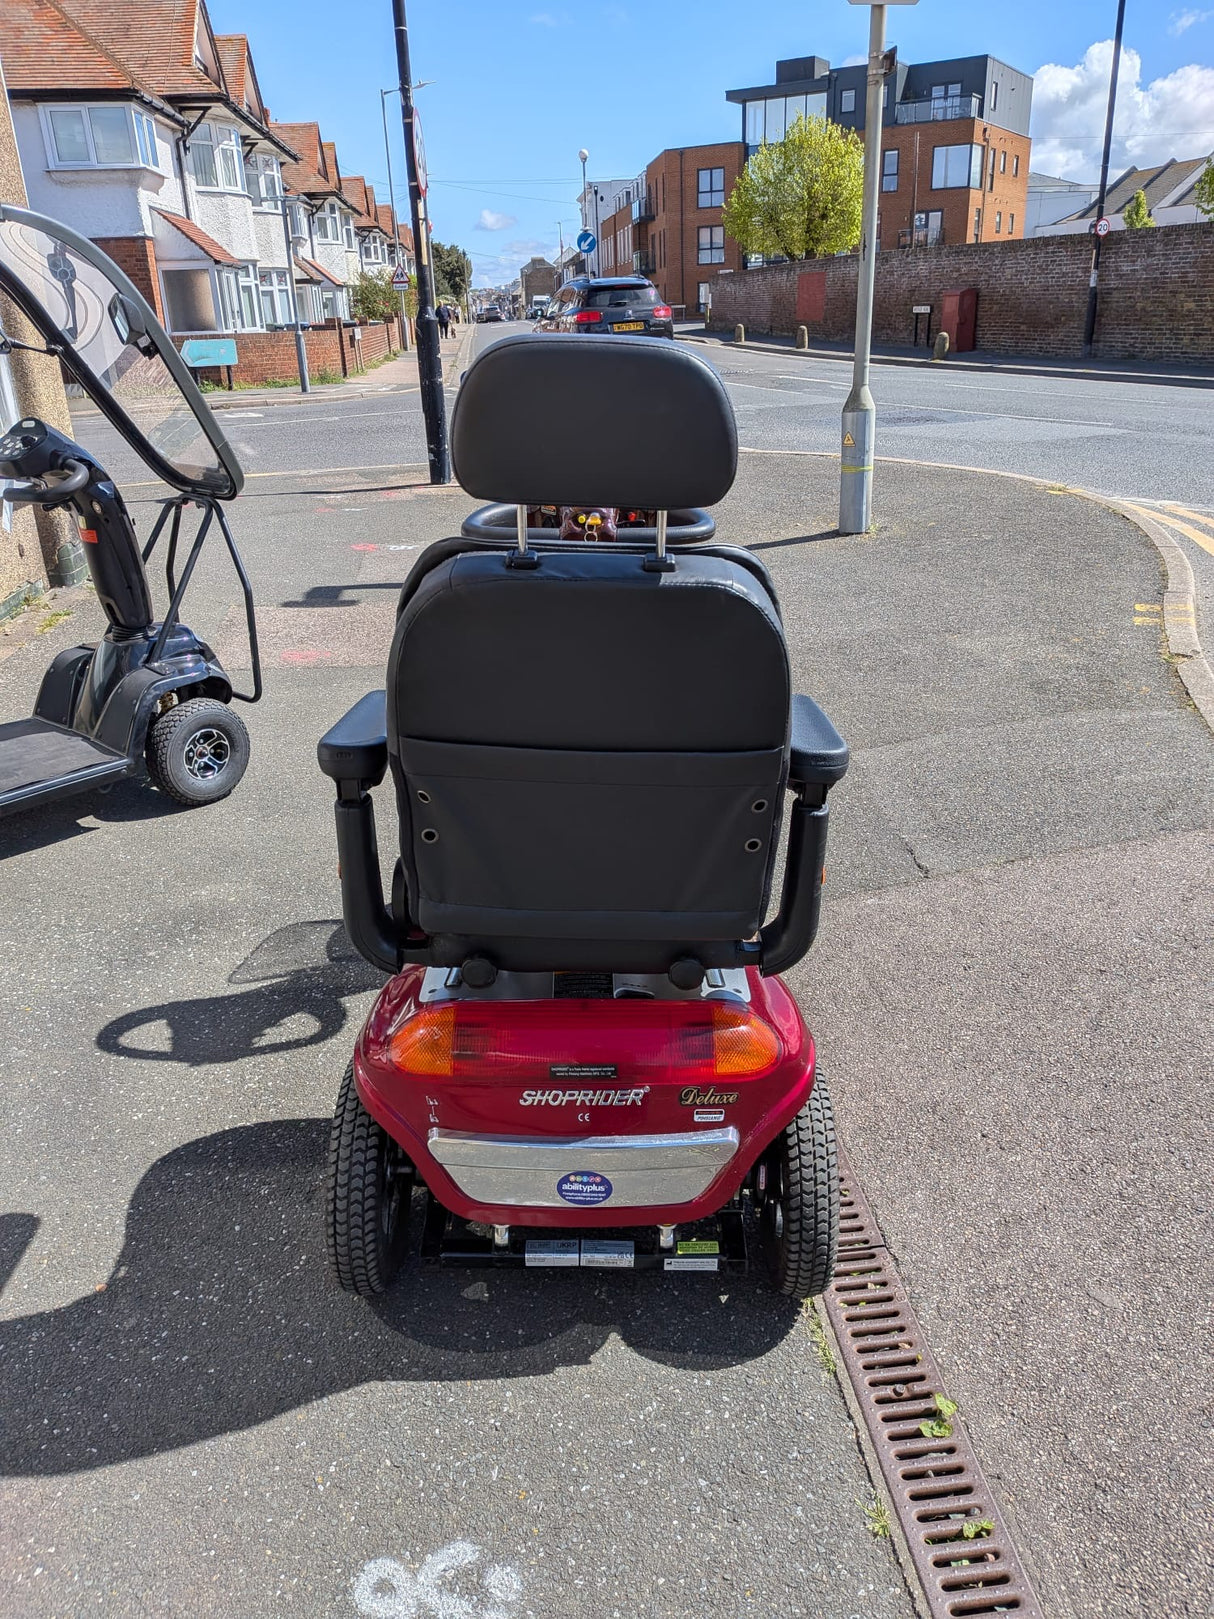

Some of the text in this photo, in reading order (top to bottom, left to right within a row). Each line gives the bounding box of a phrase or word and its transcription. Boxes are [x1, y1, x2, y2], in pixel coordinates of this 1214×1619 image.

[519, 1089, 645, 1106] SHOPRIDER
[681, 1087, 738, 1105] Deluxe
[577, 1113, 590, 1122] CE
[561, 1182, 606, 1193] abilityplus
